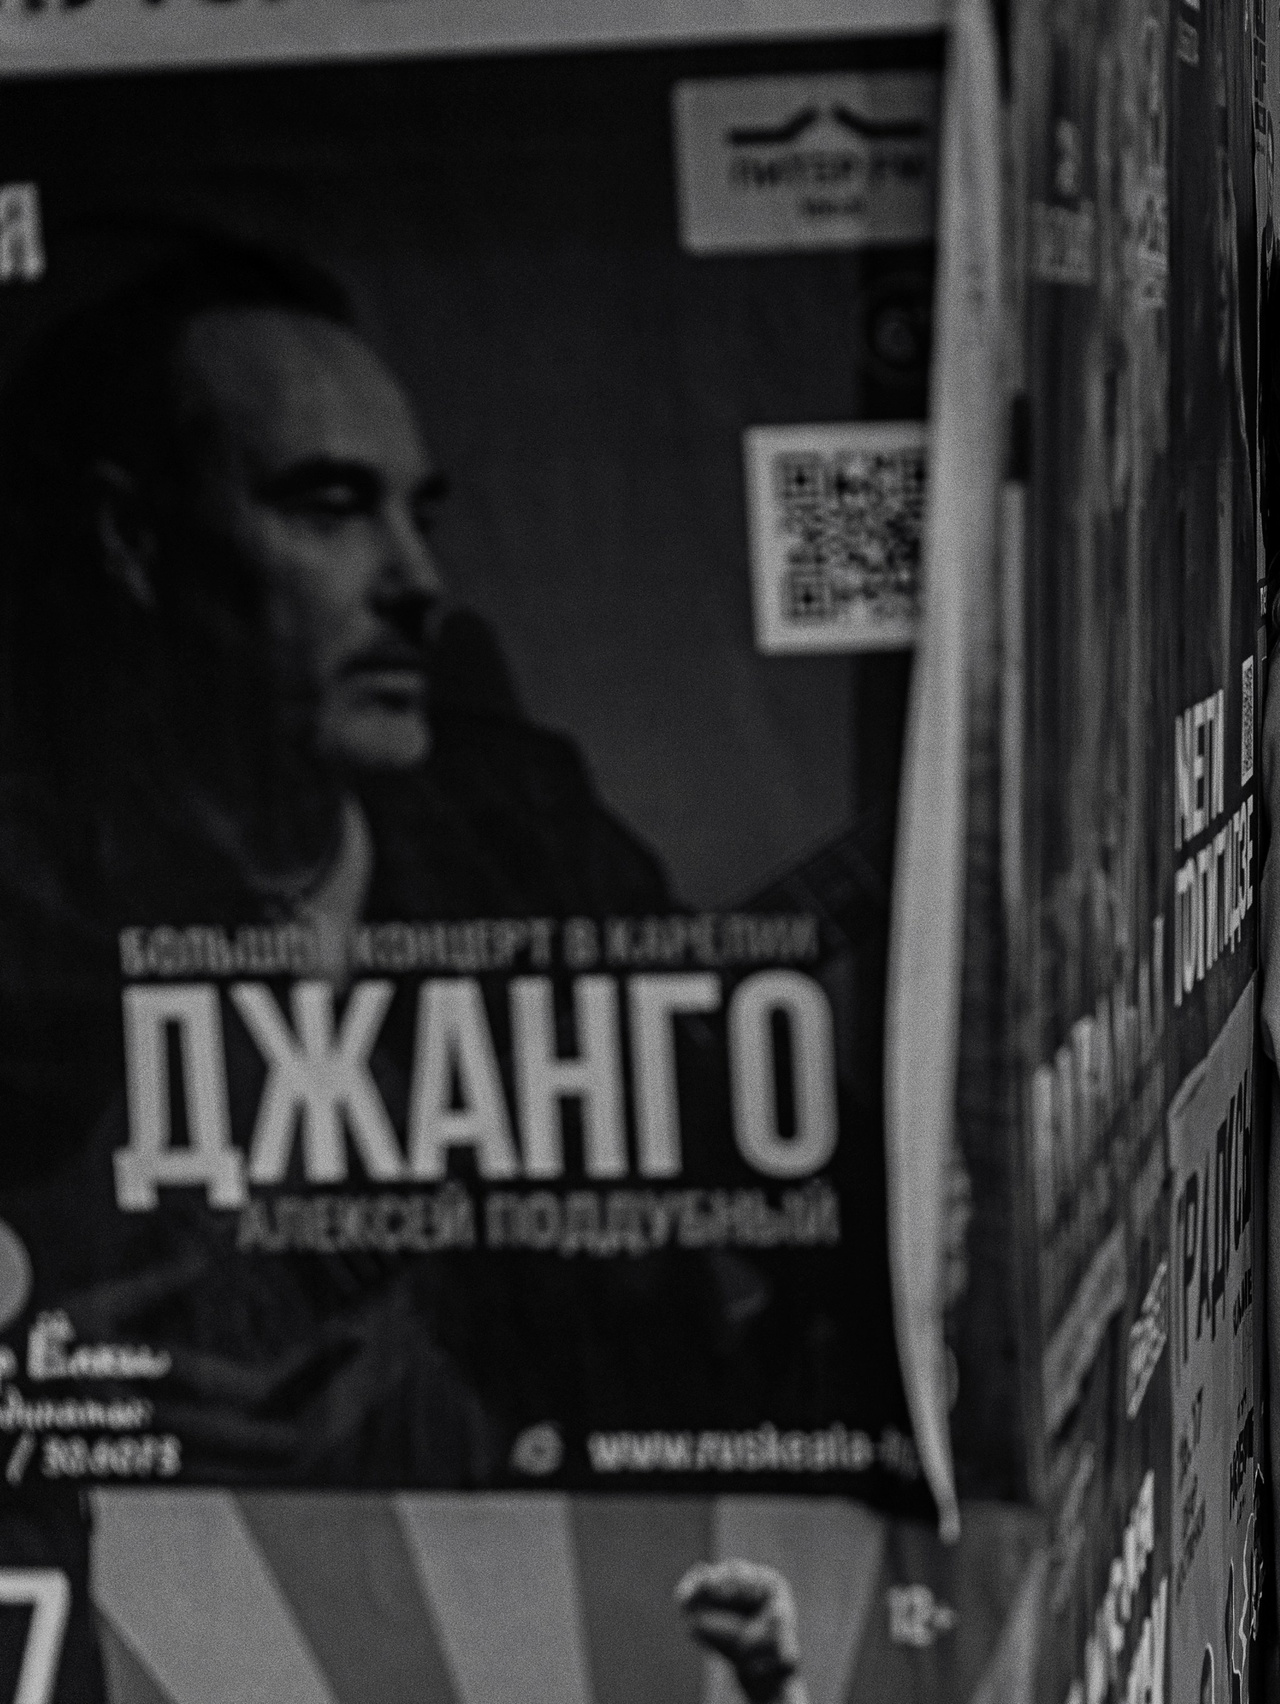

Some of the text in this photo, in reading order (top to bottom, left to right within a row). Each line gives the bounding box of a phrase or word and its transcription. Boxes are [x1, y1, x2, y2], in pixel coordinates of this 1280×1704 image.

[112, 967, 840, 1213] ДЖАНГО
[236, 1180, 842, 1259] АЛЕКСЕЙ ПОДДУБНЫЙ
